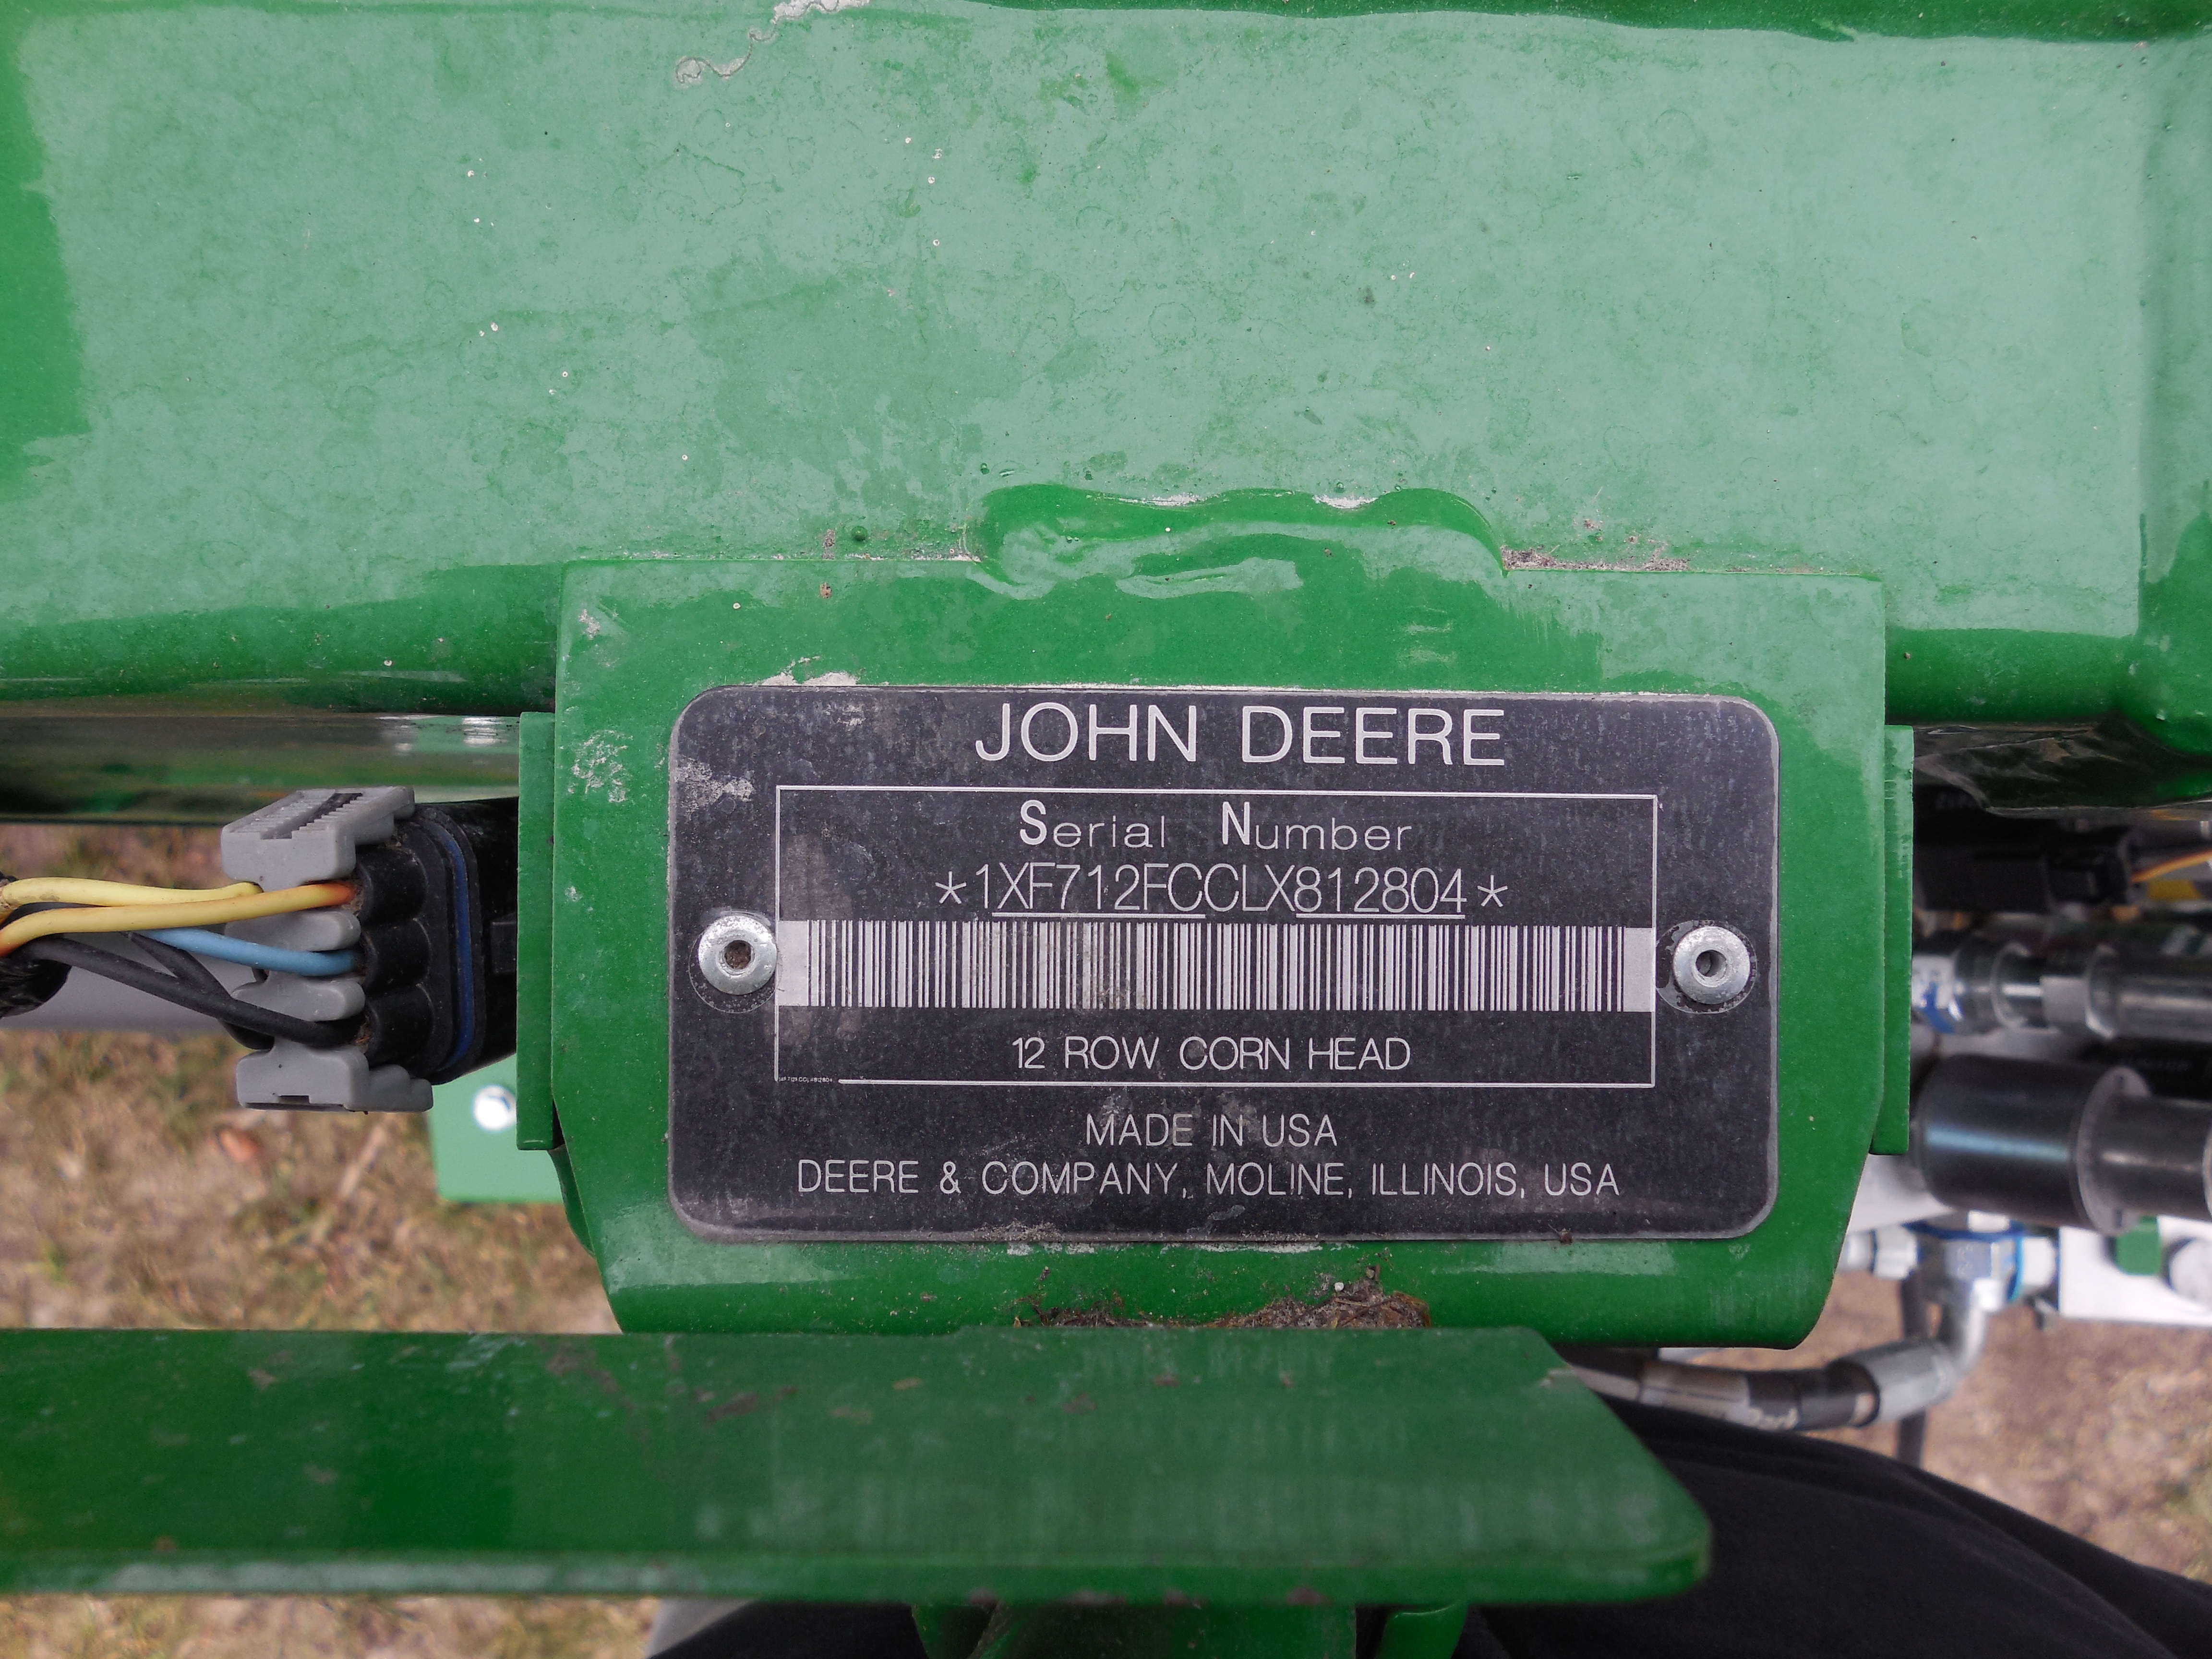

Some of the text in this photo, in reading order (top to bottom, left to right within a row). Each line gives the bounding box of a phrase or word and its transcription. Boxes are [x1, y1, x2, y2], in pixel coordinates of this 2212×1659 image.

[974, 702, 1505, 766] JOHN DEERE
[1019, 799, 1413, 851] Serial Number
[1012, 1035, 1411, 1071] 12 ROW CORN HEAD
[1086, 1113, 1338, 1147] MADE IN USA
[798, 1159, 1620, 1200] DEERE & COMPANY, MOLINE, ILLINOIS, USA
